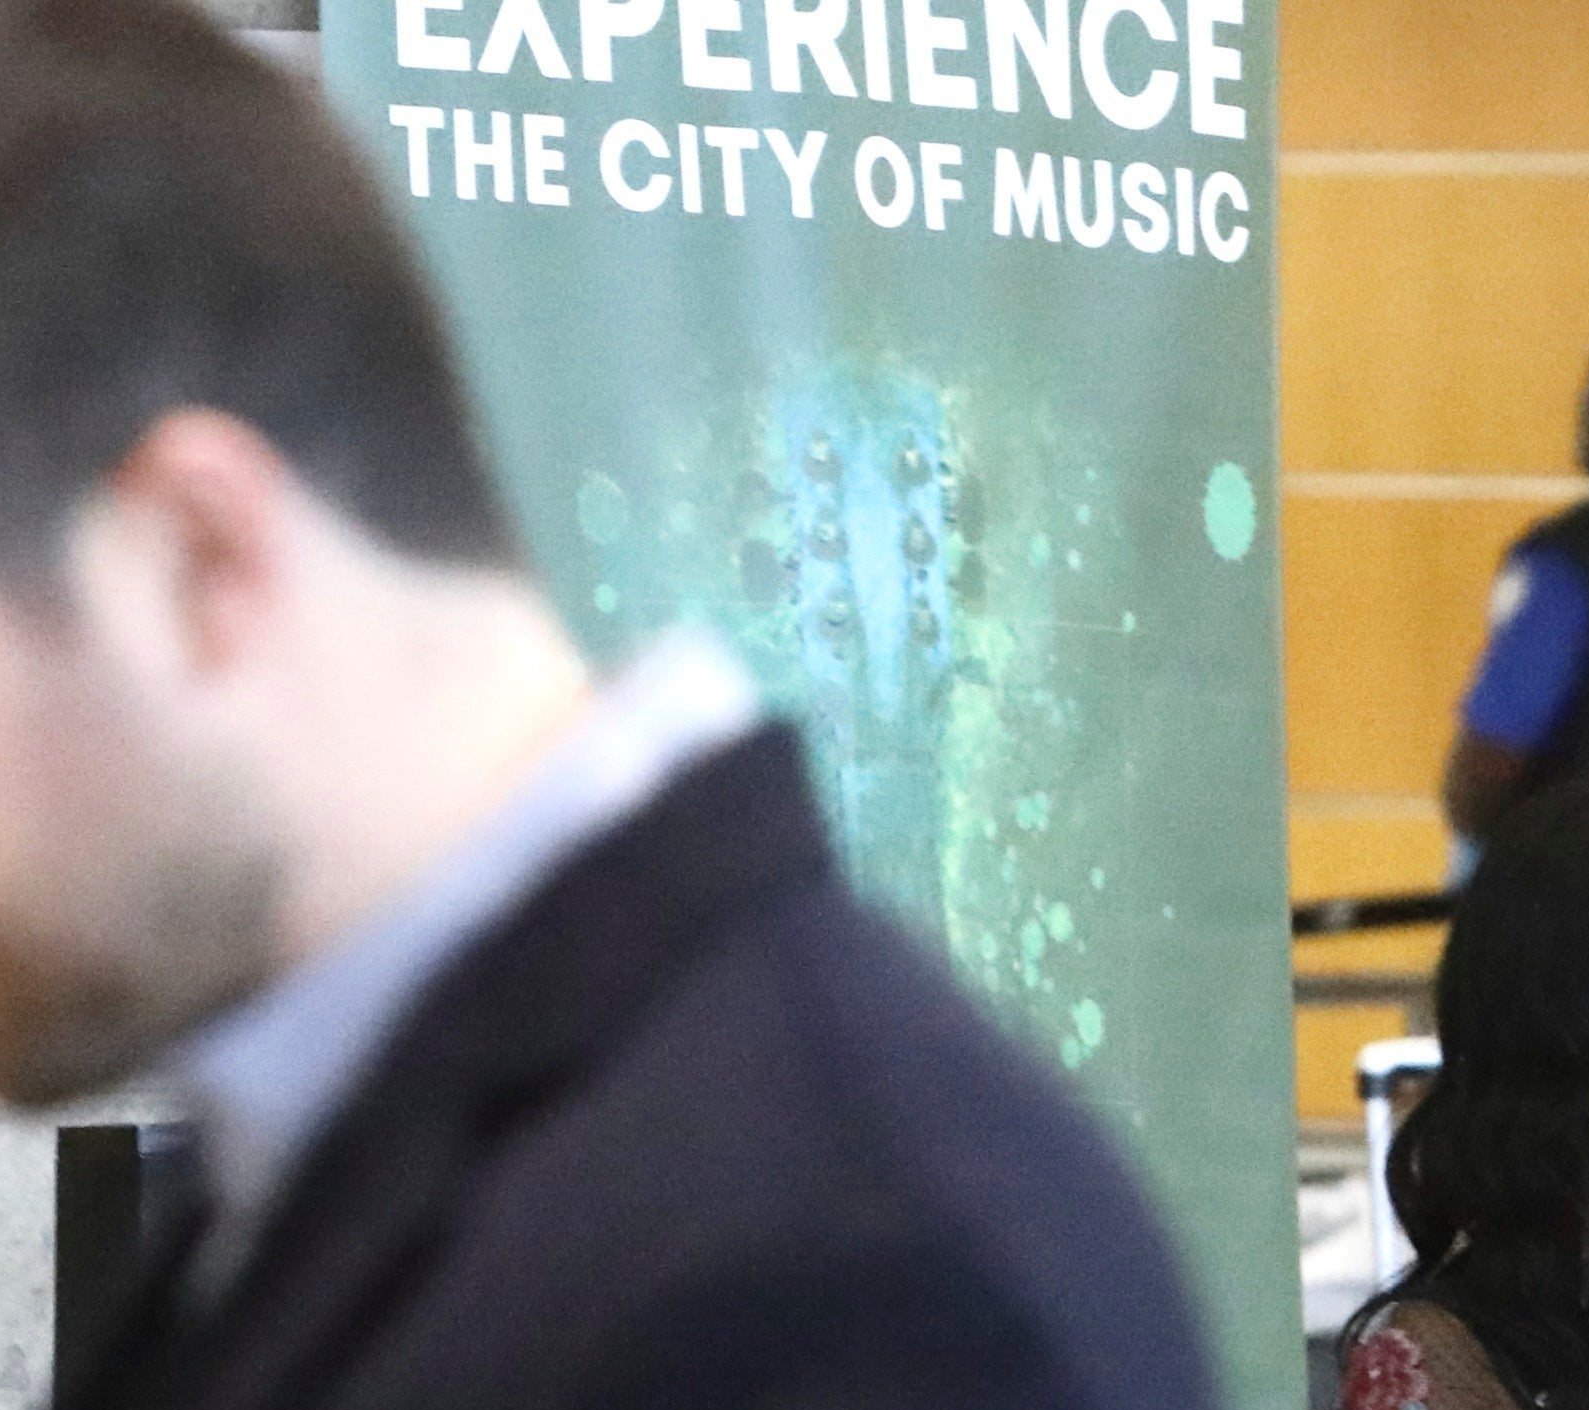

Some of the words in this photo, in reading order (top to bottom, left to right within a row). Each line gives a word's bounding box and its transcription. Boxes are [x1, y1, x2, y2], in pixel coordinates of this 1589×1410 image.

[393, 0, 1249, 141] EXPERIENCE
[386, 102, 573, 208] THE
[597, 116, 830, 220] CITY
[852, 134, 966, 232] OF
[991, 146, 1252, 265] MUSIC
